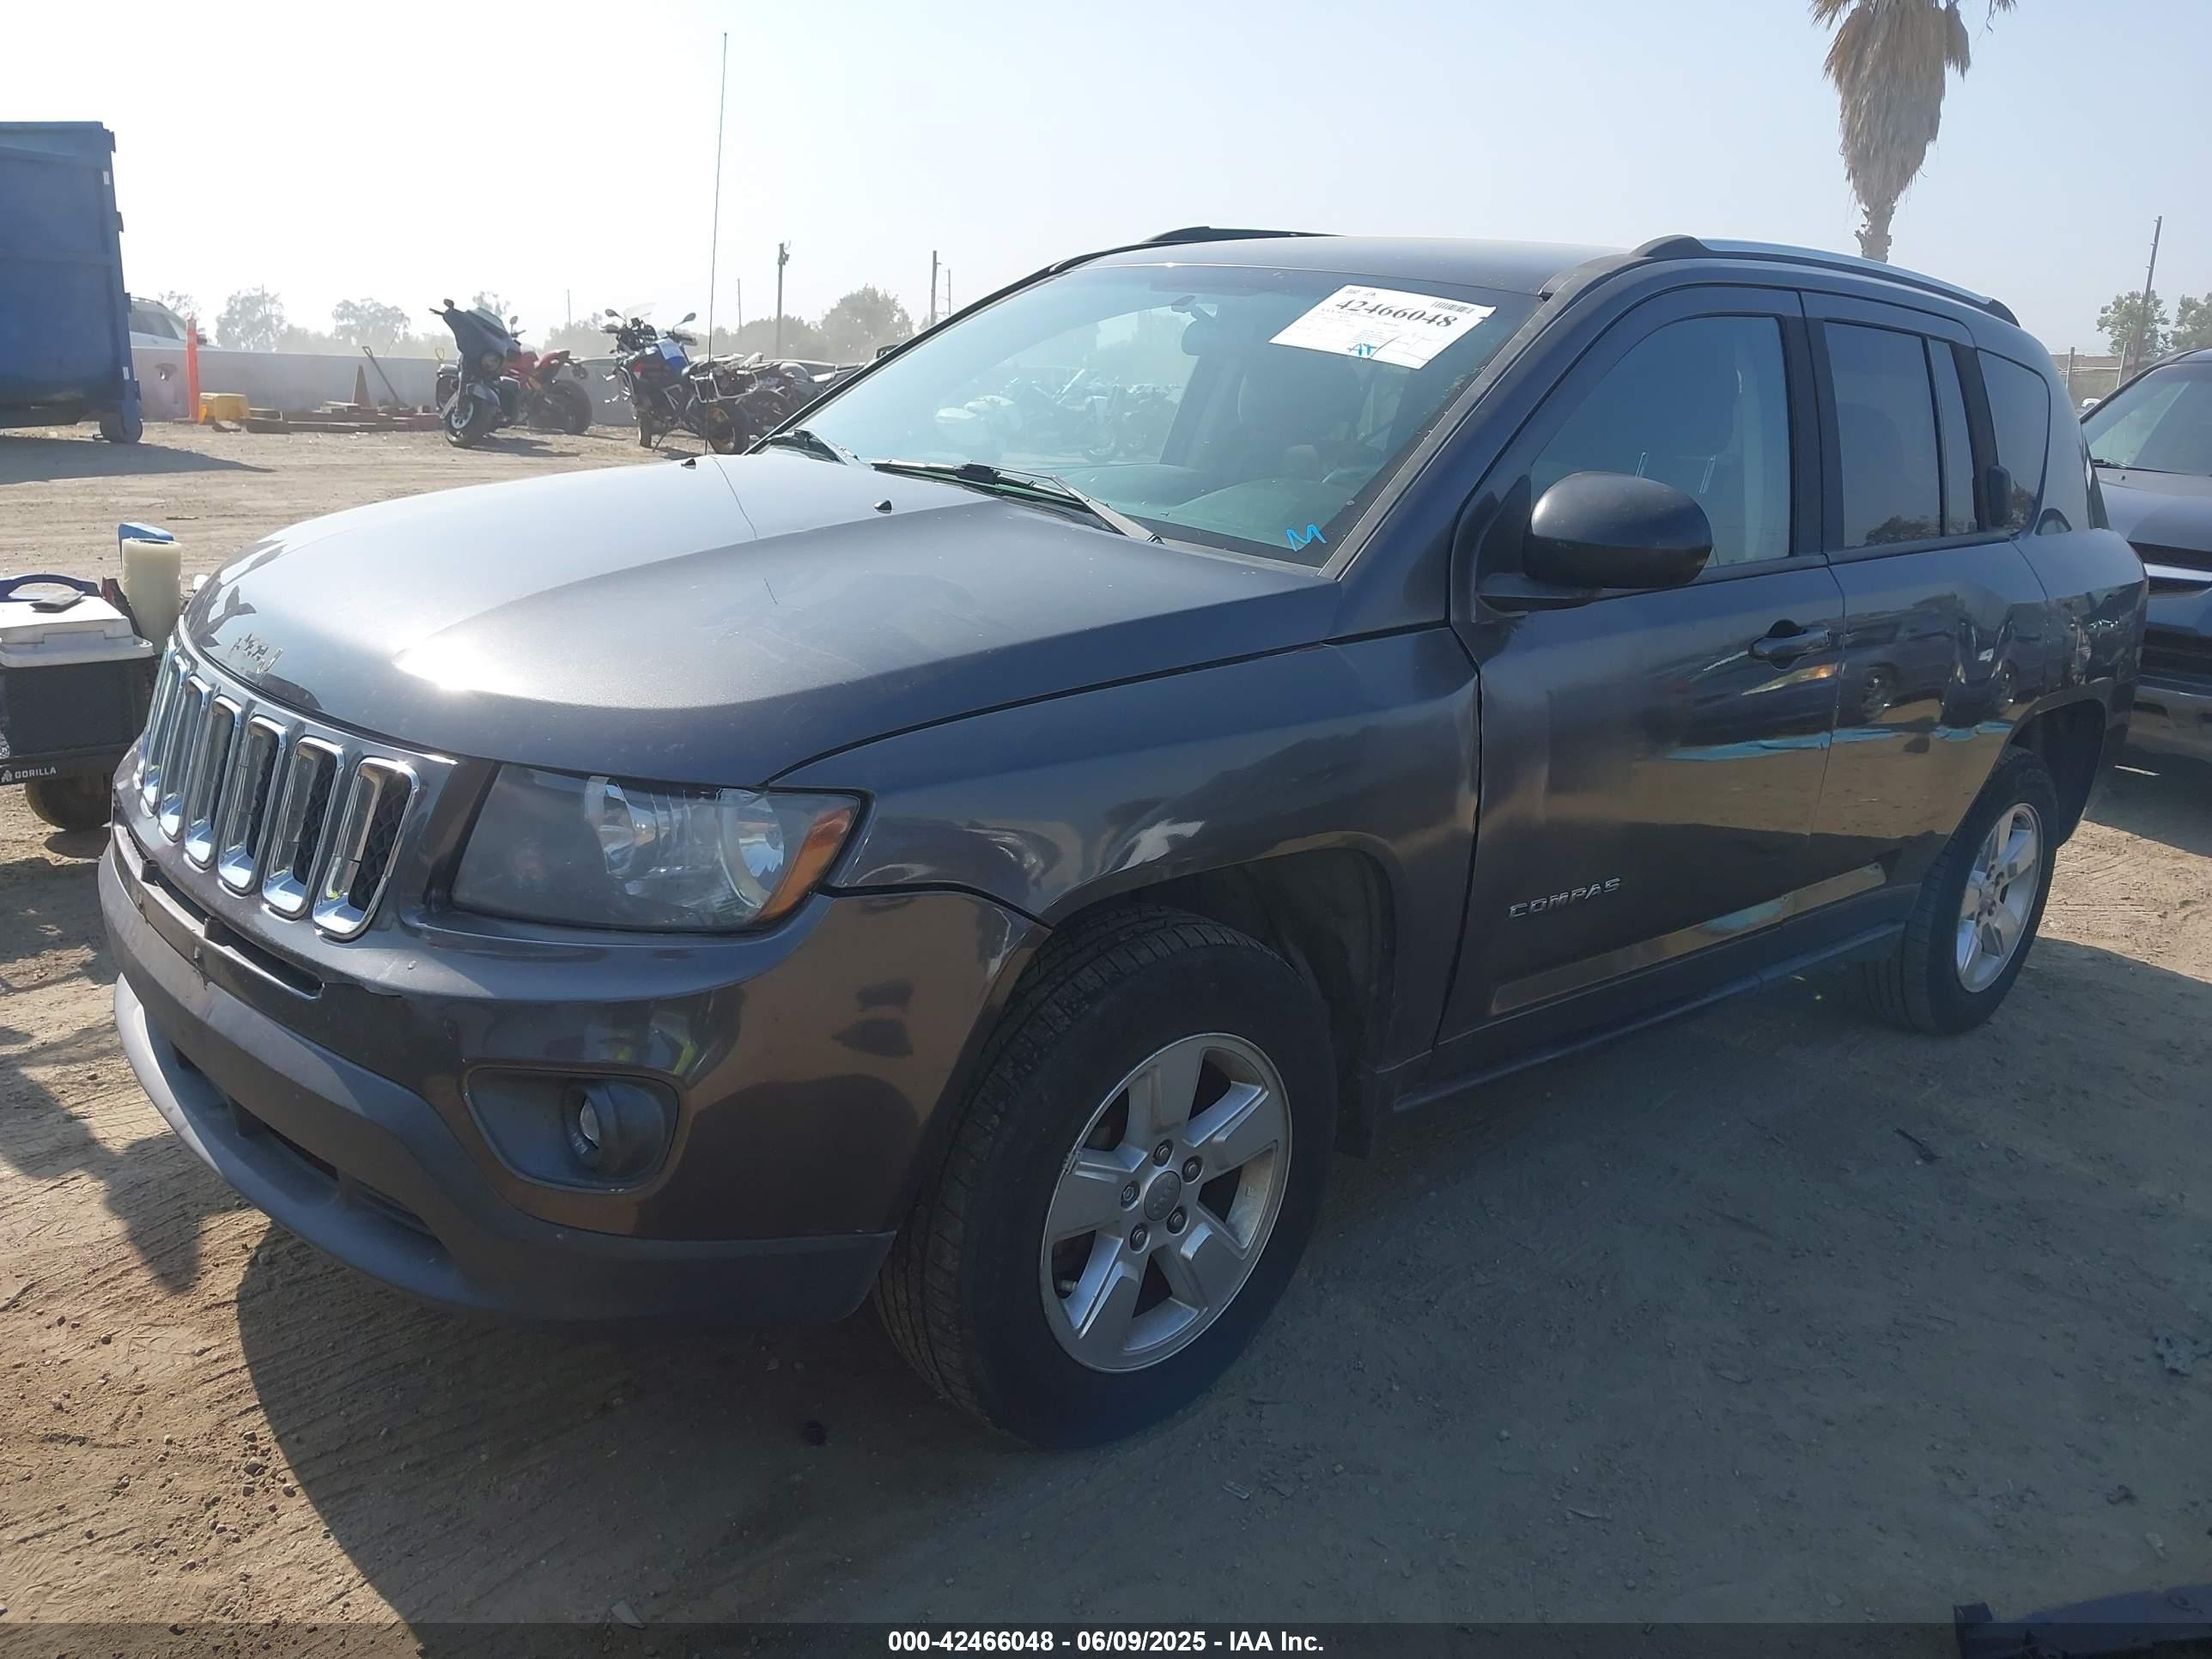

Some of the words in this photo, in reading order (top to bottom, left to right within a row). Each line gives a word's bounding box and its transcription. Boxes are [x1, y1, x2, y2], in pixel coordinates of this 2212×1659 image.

[1335, 299, 1458, 327] 42466048
[1286, 524, 1328, 552] M
[15, 766, 57, 779] GORILLA
[1509, 878, 1621, 919] COMPAS
